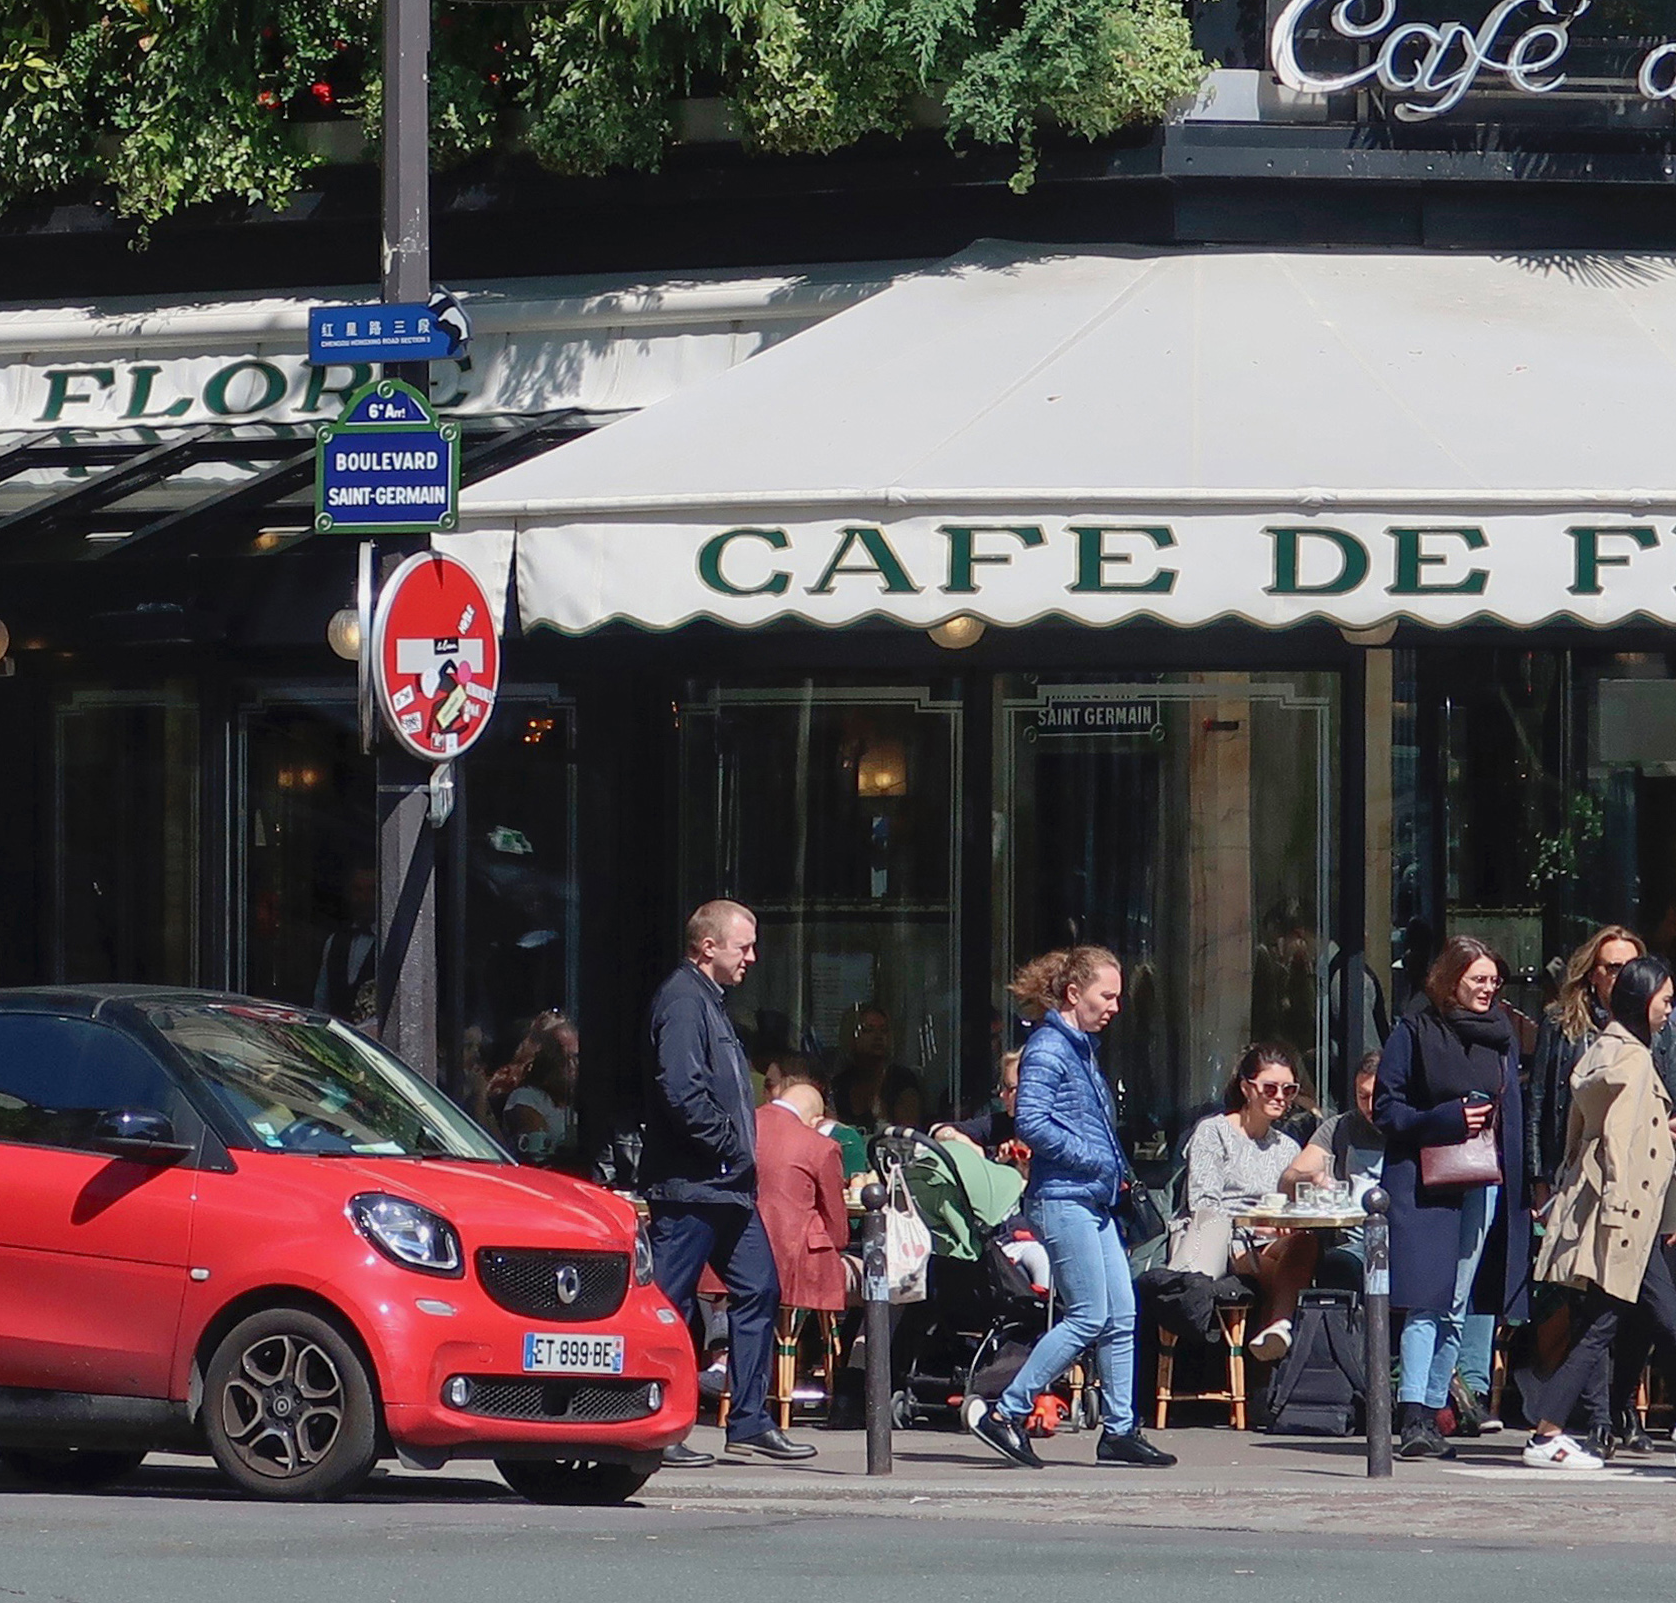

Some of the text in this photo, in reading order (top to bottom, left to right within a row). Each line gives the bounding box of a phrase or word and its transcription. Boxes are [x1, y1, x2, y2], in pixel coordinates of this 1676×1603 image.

[336, 451, 439, 471] BOULEVARD
[328, 486, 446, 506] SAINT-GERMAIN
[695, 523, 1180, 597] CAFE
[1260, 524, 1491, 597] DE
[1038, 706, 1152, 726] SAINT GERMAIN
[534, 1339, 613, 1367] ET-899-BE
